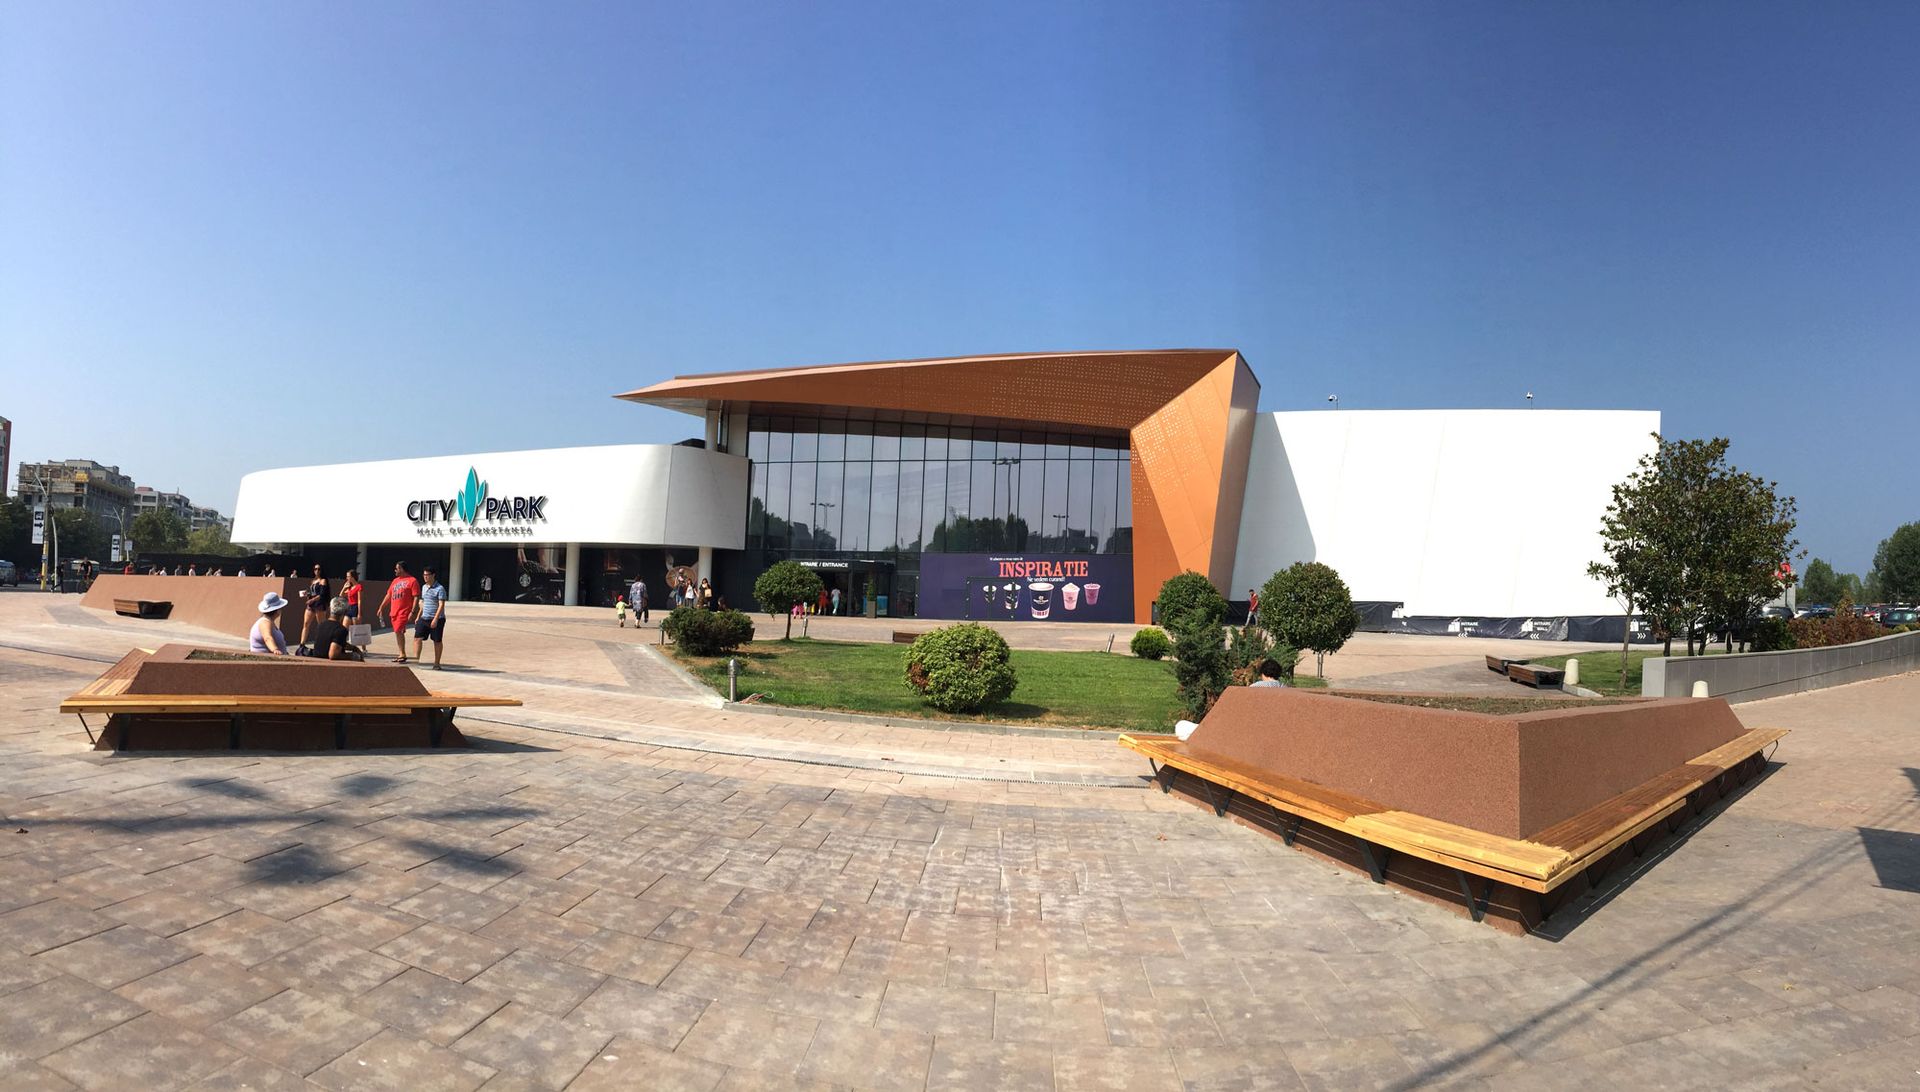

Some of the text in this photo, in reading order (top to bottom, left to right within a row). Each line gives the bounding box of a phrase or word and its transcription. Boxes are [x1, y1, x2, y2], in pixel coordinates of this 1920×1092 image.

[407, 496, 546, 522] CITY PARK
[417, 527, 443, 537] MALL
[449, 526, 463, 536] OF
[999, 561, 1088, 577] INSPIRATIE
